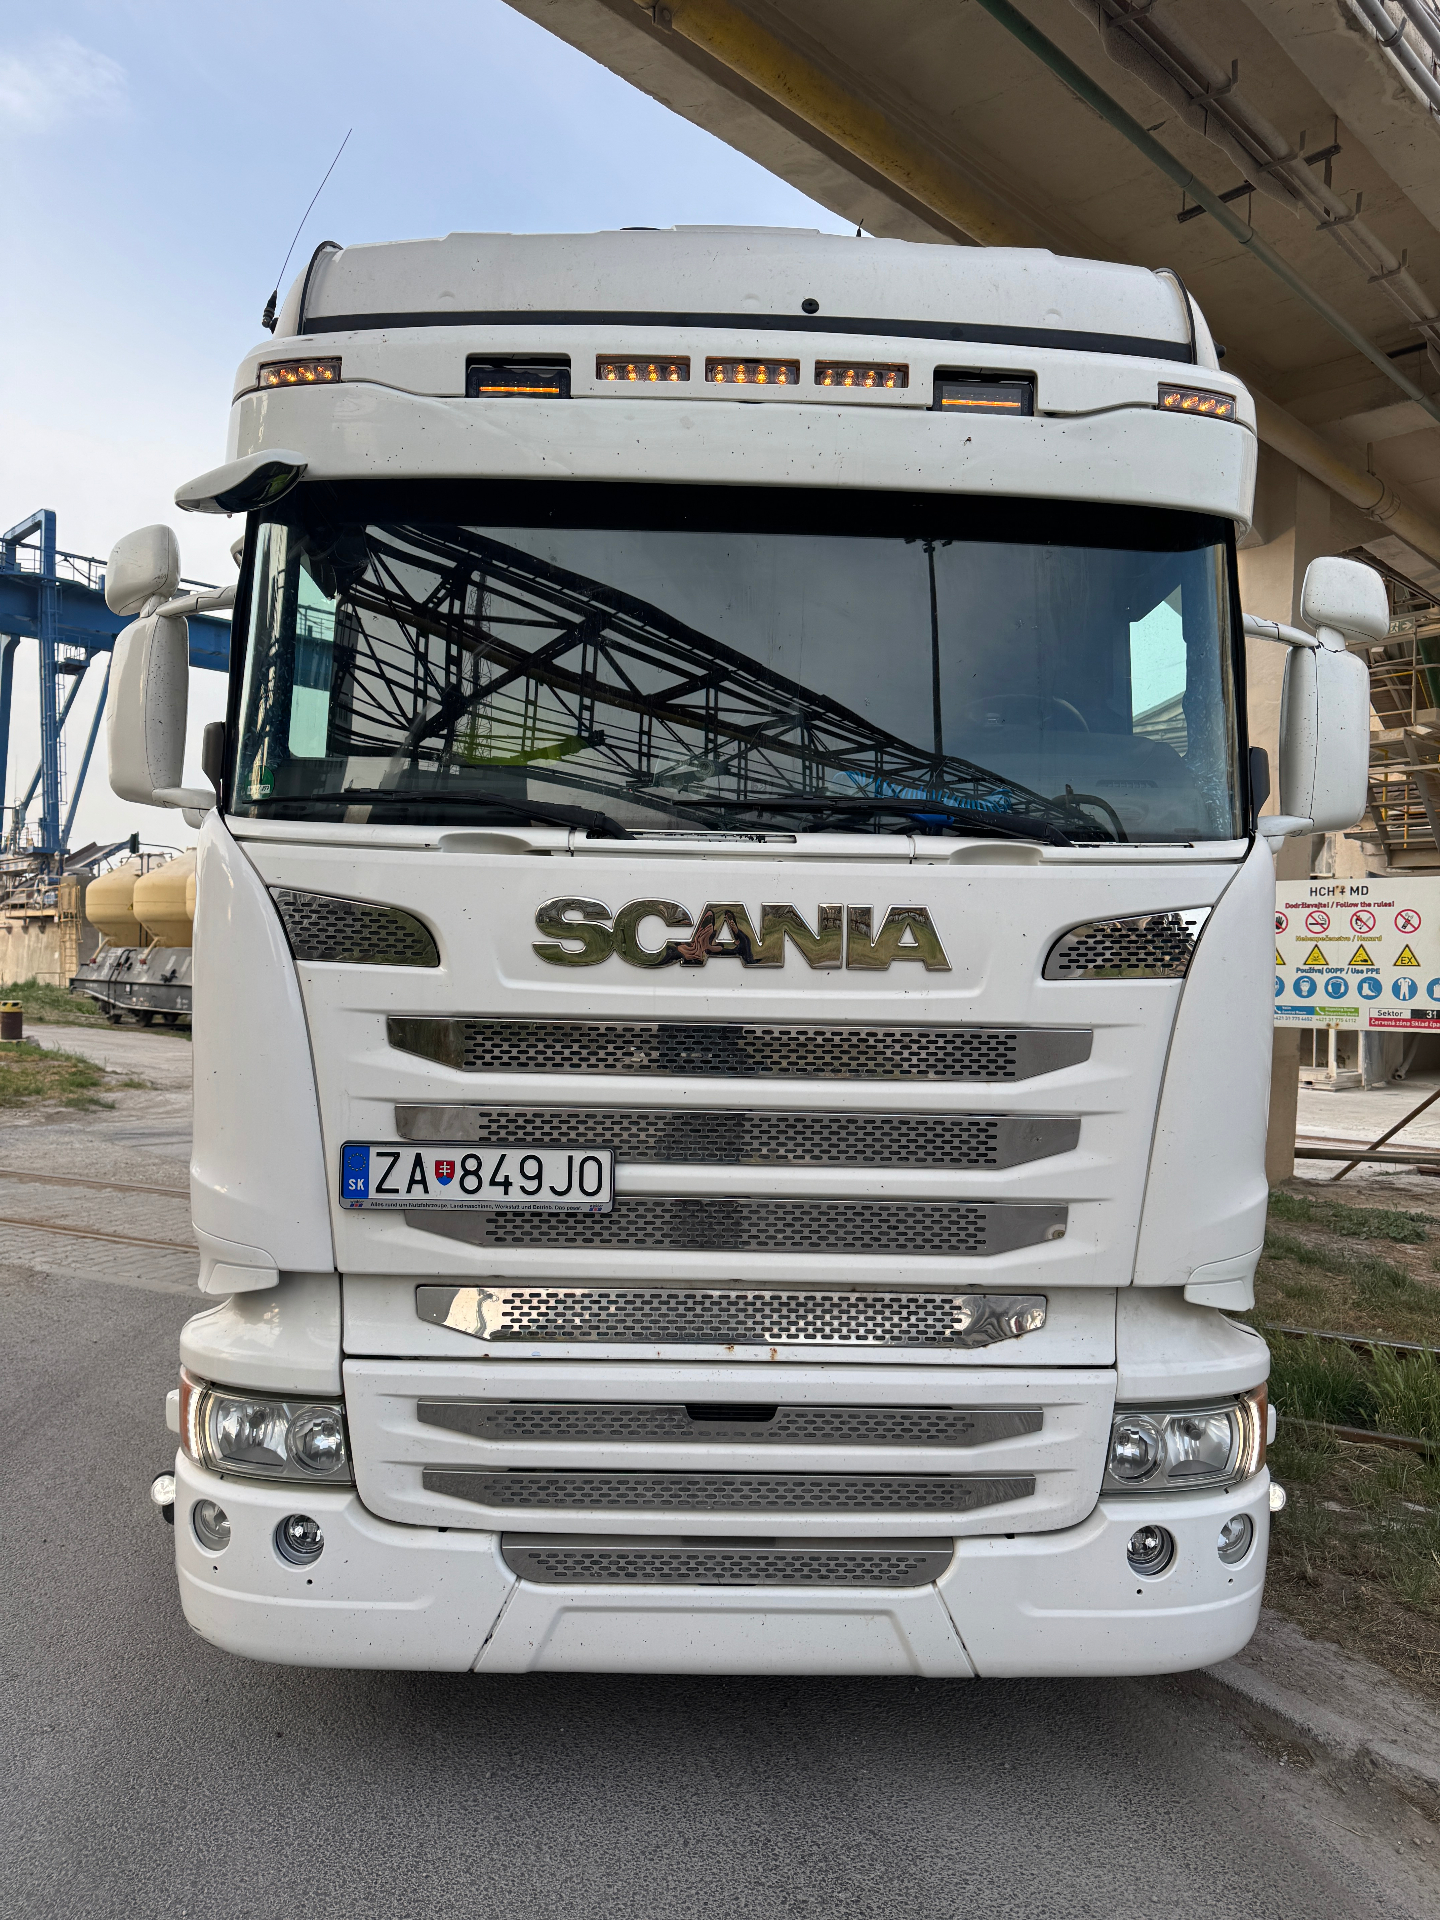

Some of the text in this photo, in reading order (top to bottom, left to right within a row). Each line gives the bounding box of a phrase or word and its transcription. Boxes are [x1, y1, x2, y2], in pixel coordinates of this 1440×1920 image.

[1309, 886, 1335, 897] HCH
[1349, 885, 1369, 896] MD
[1373, 900, 1394, 908] rules!
[531, 895, 953, 971] SCANIA
[1426, 1010, 1437, 1019] 31
[1371, 1018, 1395, 1026] Červená
[375, 1151, 603, 1196] ZA 849JO
[348, 1178, 365, 1190] SK
